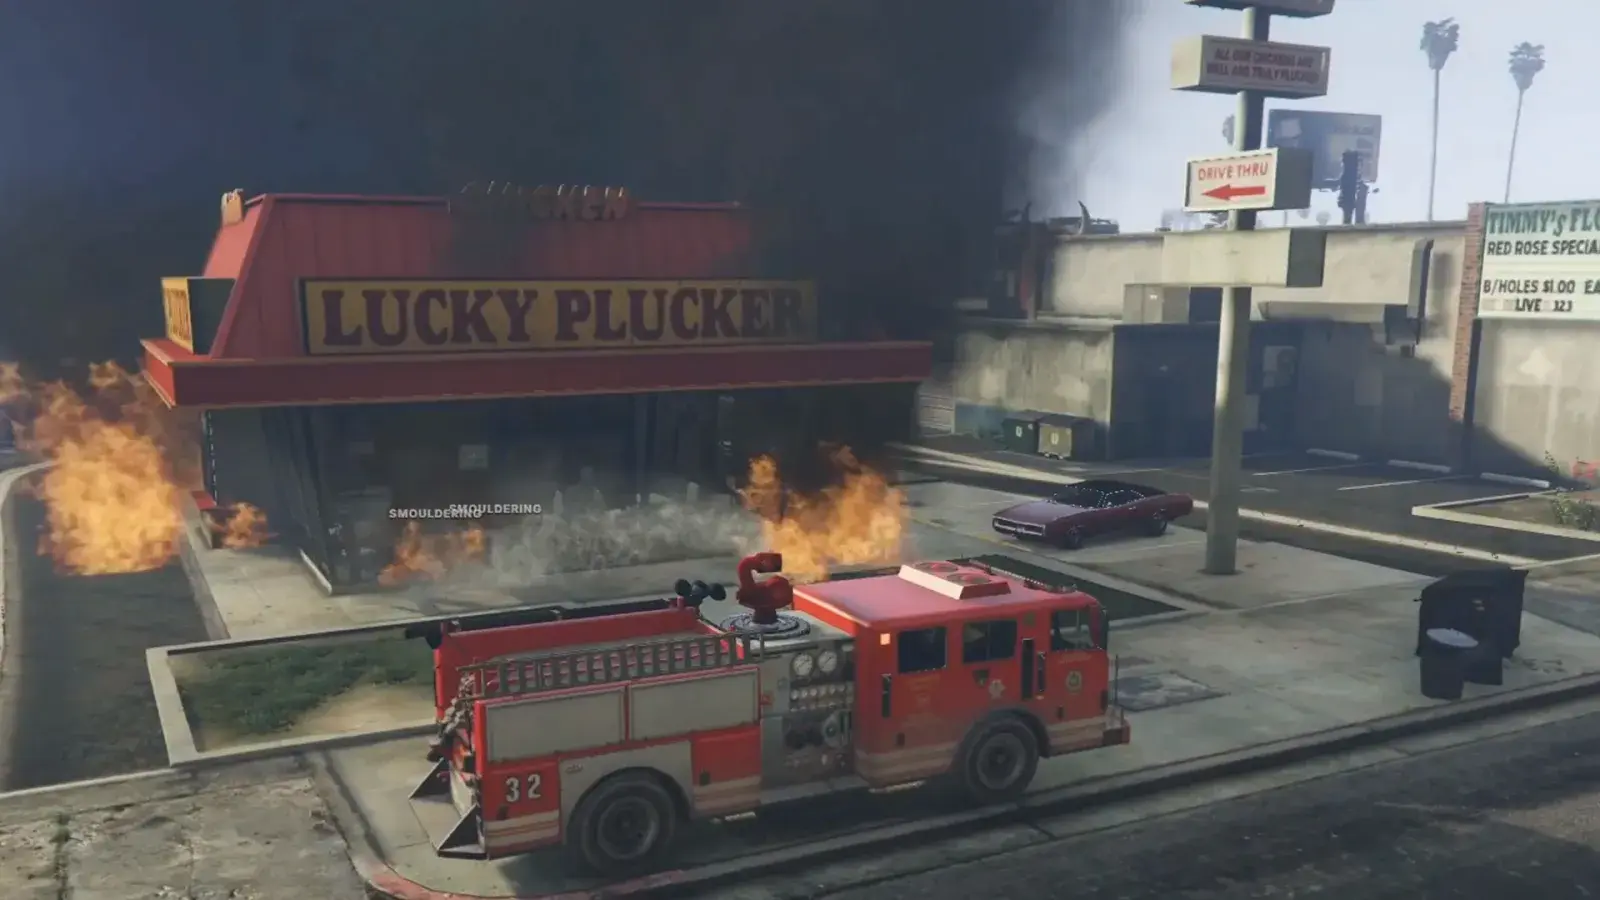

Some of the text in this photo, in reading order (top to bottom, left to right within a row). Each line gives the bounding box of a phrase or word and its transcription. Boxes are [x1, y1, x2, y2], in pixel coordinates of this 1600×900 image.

[1198, 162, 1269, 181] DRIVE THRU
[1487, 239, 1600, 255] RED ROSE SPECIA
[1483, 279, 1539, 296] B/HOLES
[1515, 298, 1542, 312] LIVE
[321, 287, 805, 346] LUCKY PLUCKER
[506, 774, 541, 802] 32
